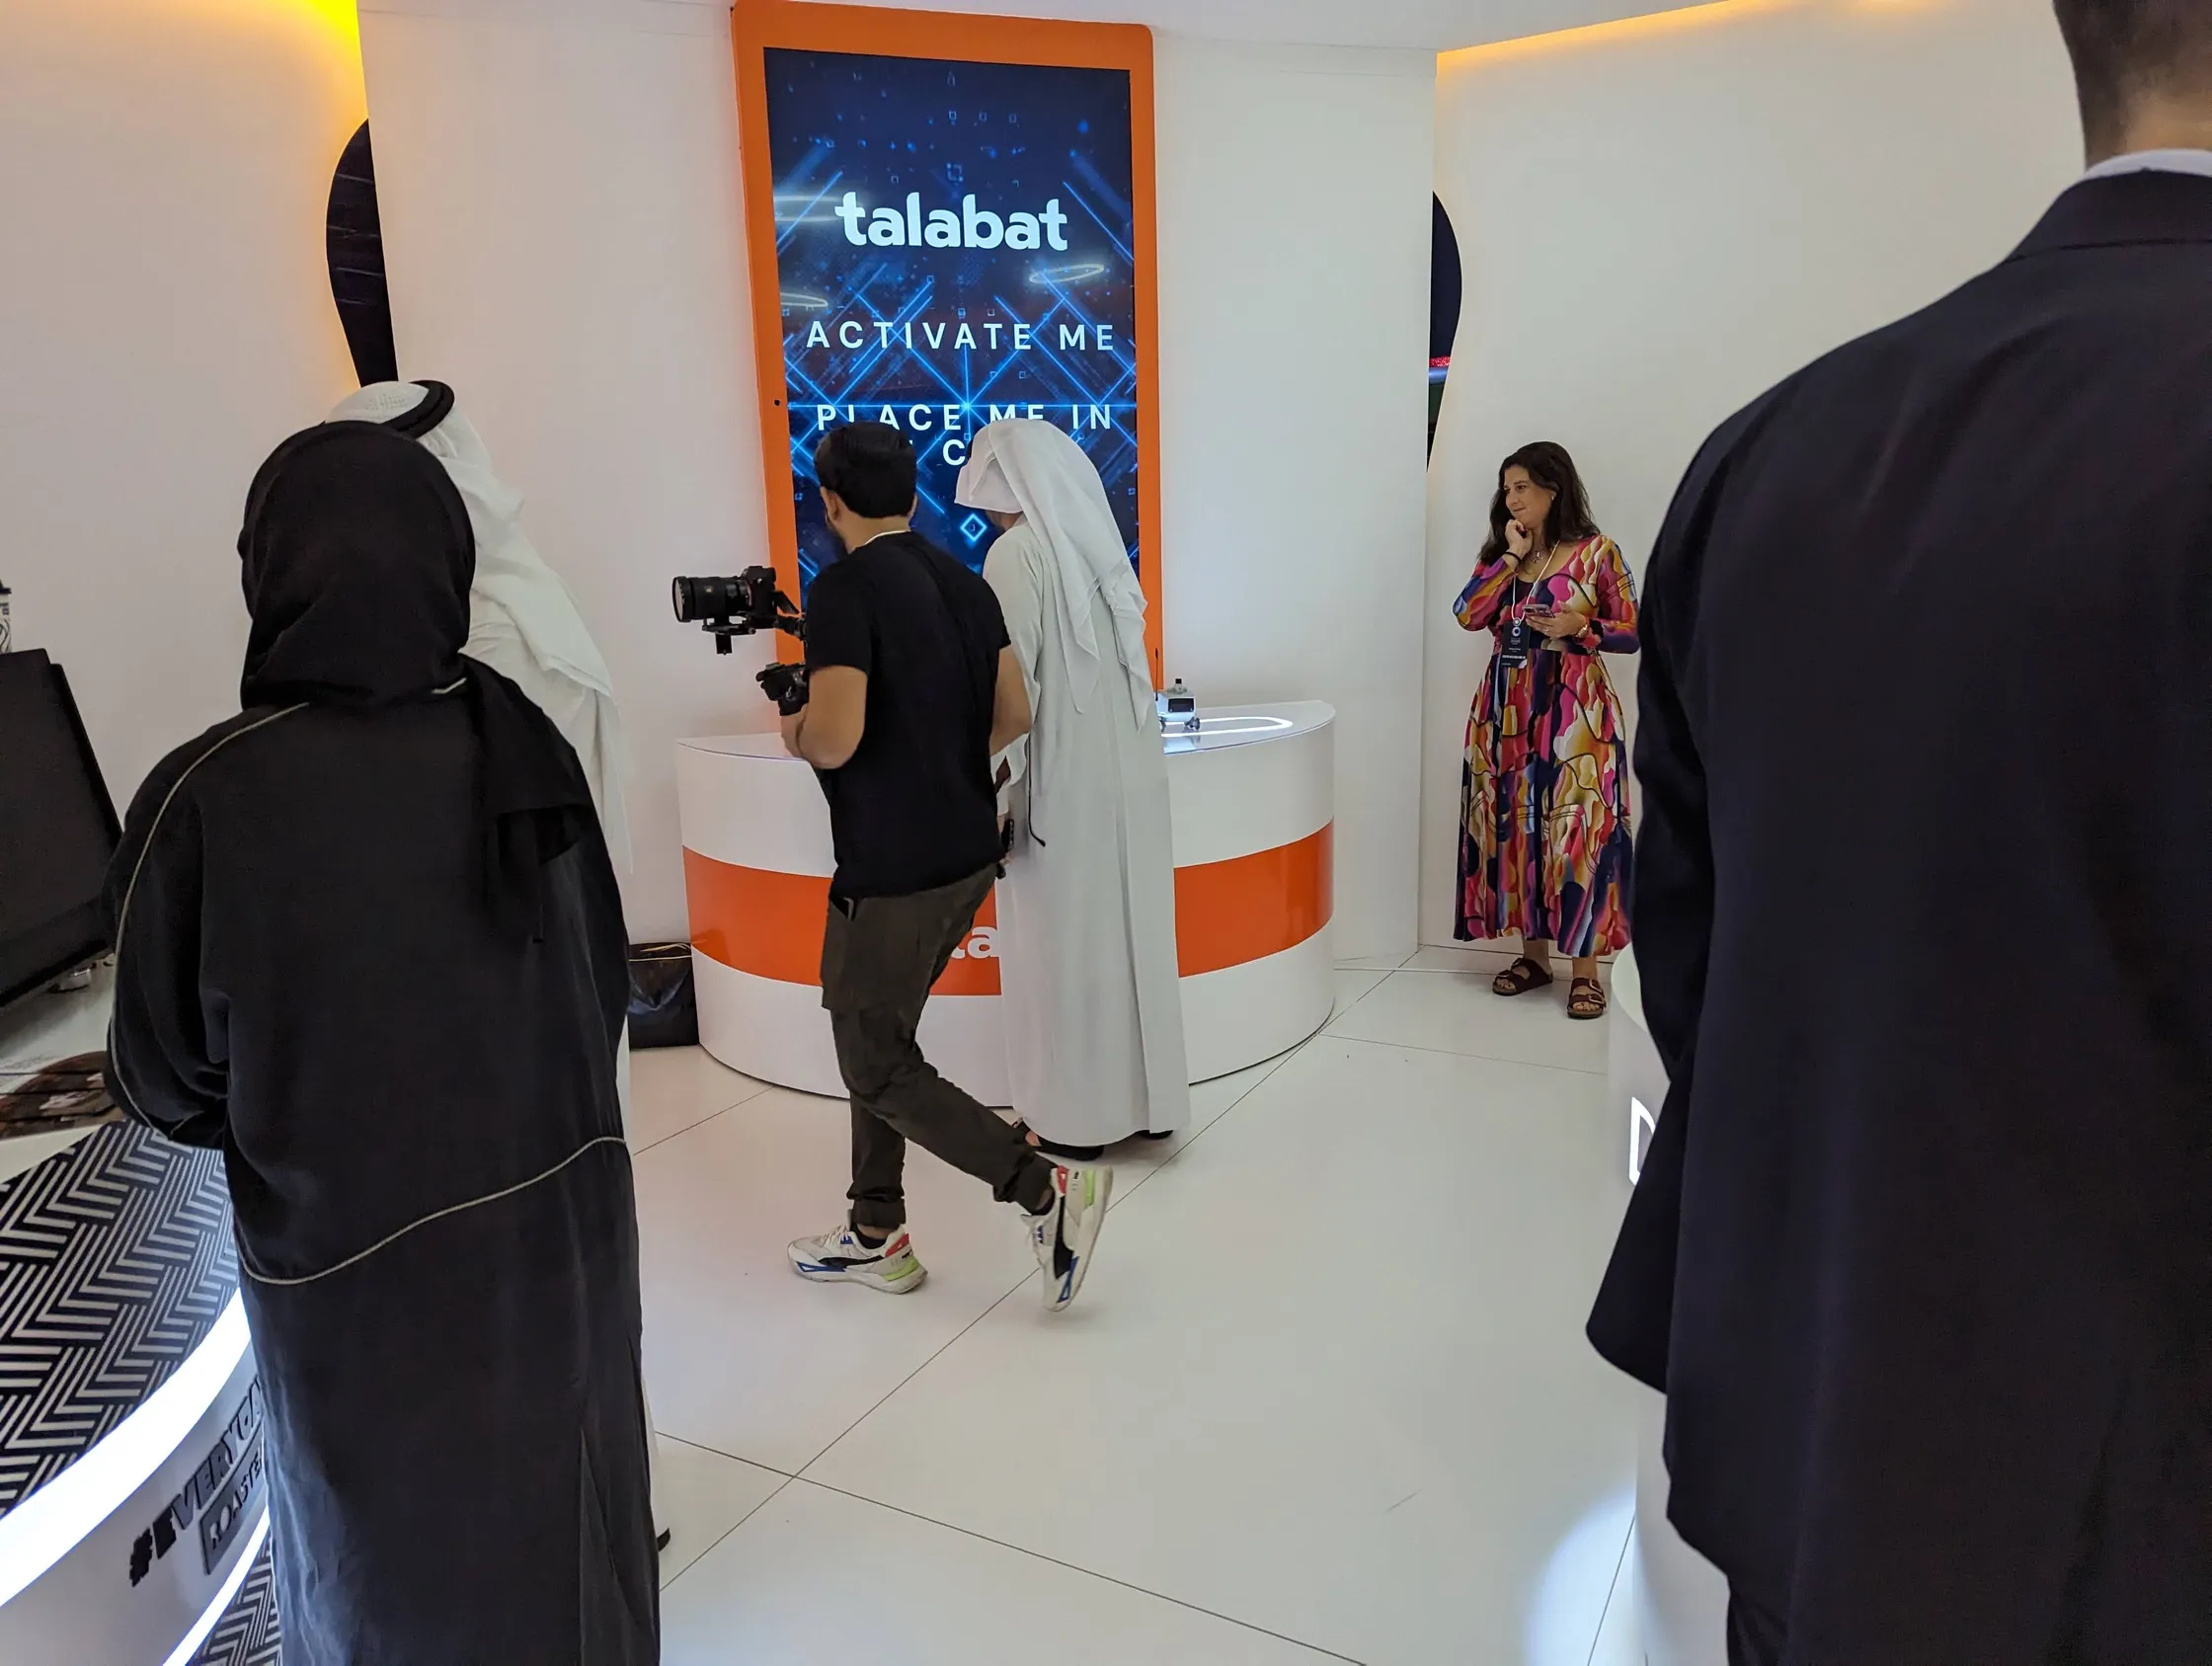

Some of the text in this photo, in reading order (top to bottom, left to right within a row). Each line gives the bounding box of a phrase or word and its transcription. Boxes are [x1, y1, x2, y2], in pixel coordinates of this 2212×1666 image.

[834, 192, 1068, 251] talabat
[806, 320, 1115, 351] ACTIVATE ME
[1072, 404, 1111, 430] IN
[207, 1445, 264, 1550] ROASTE
